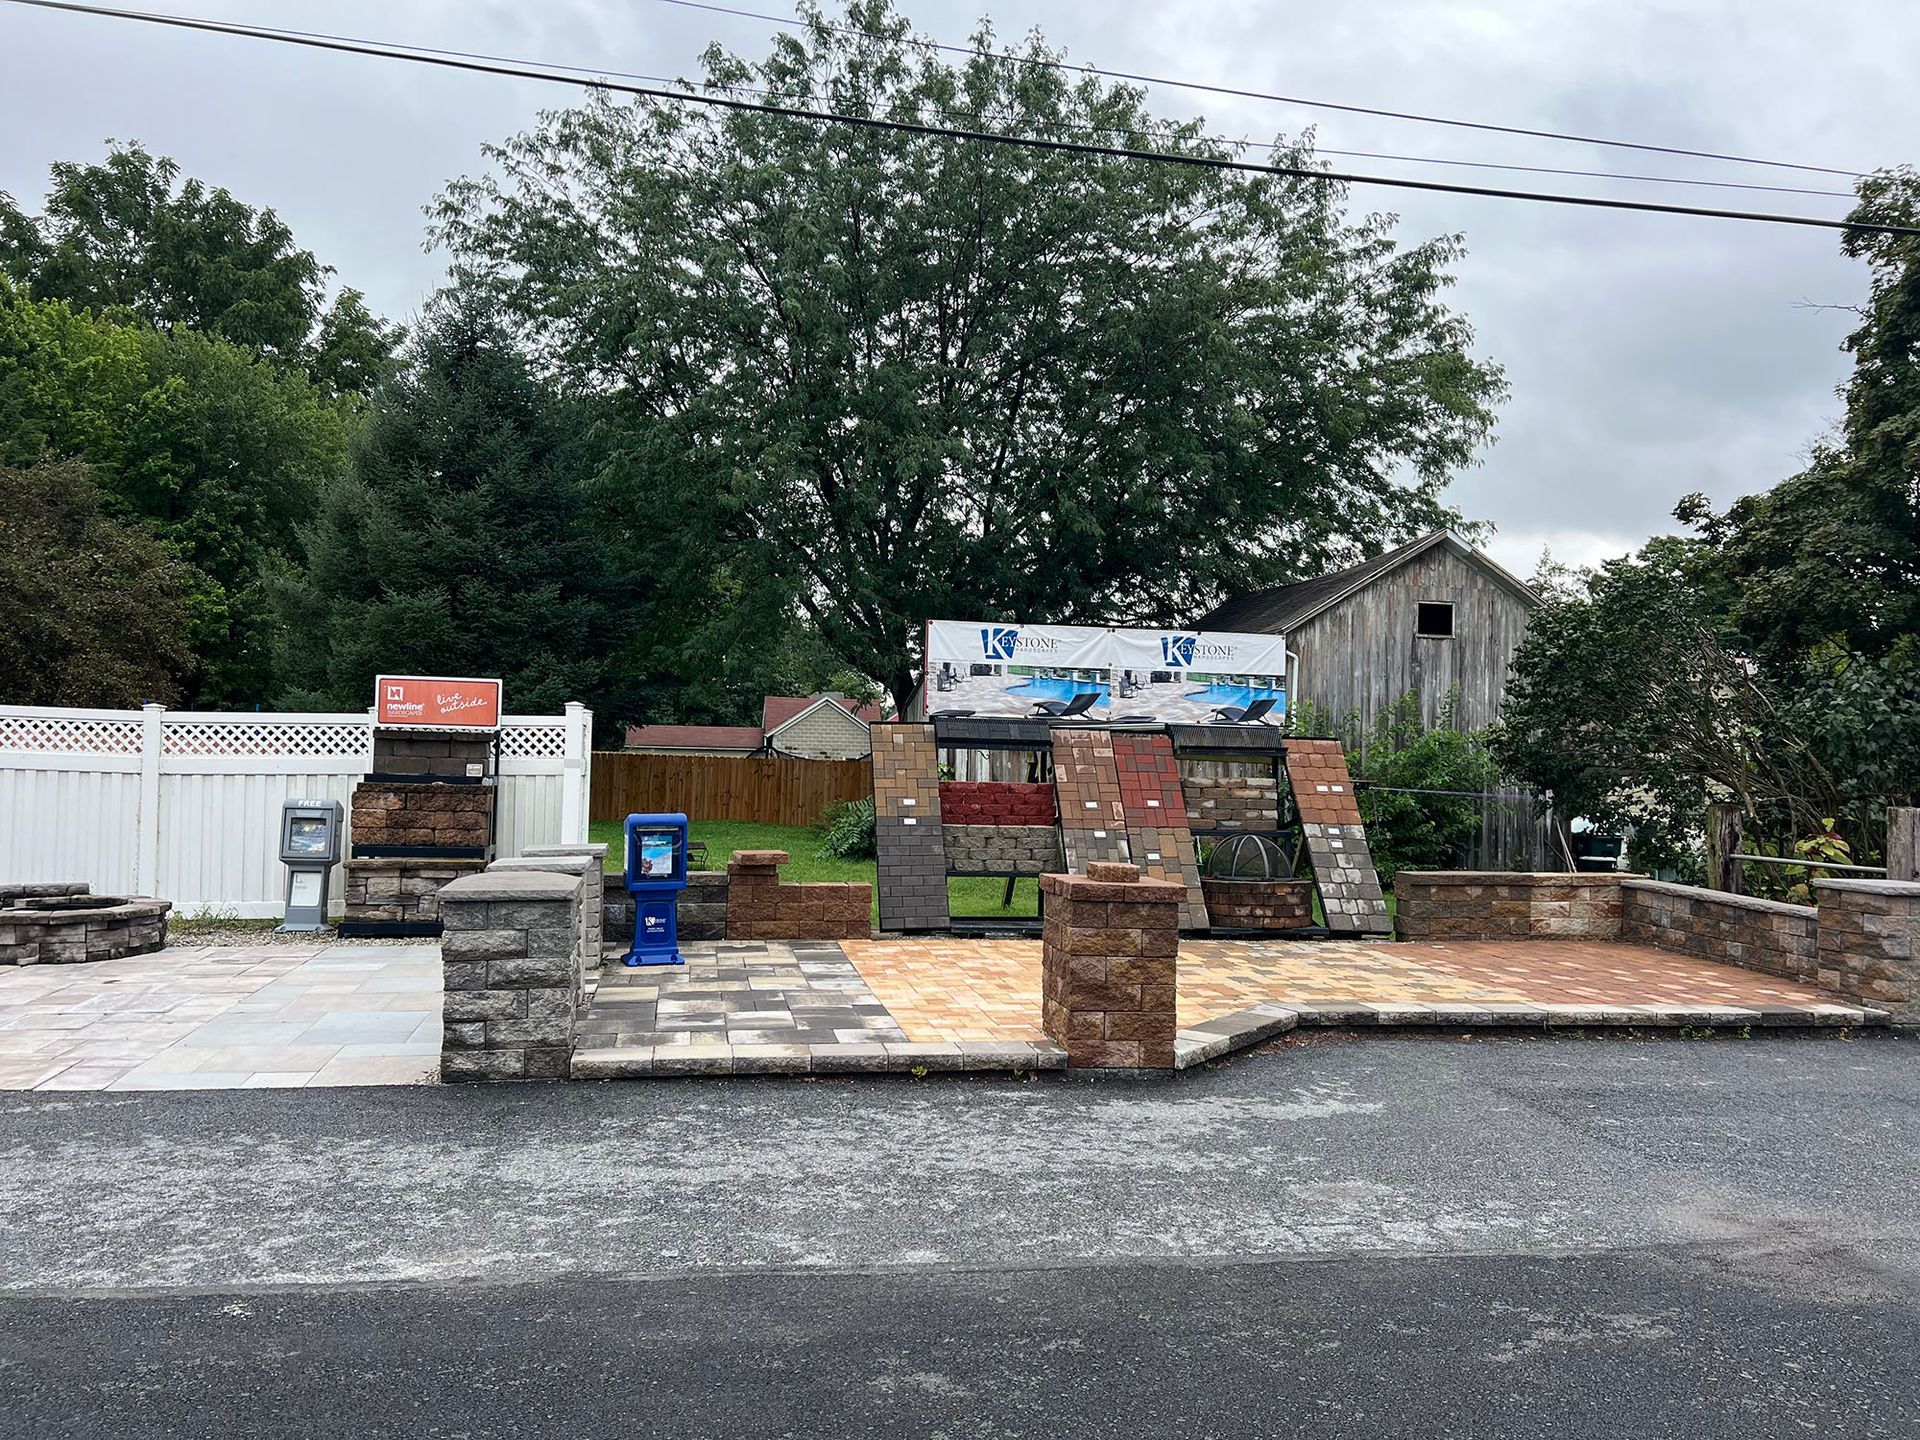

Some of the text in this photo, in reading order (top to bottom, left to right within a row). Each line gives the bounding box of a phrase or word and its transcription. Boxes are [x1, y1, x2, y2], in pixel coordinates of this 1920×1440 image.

[982, 627, 1058, 660] KEYSTONE
[1161, 635, 1235, 667] KEYSTONE
[436, 692, 462, 705] live
